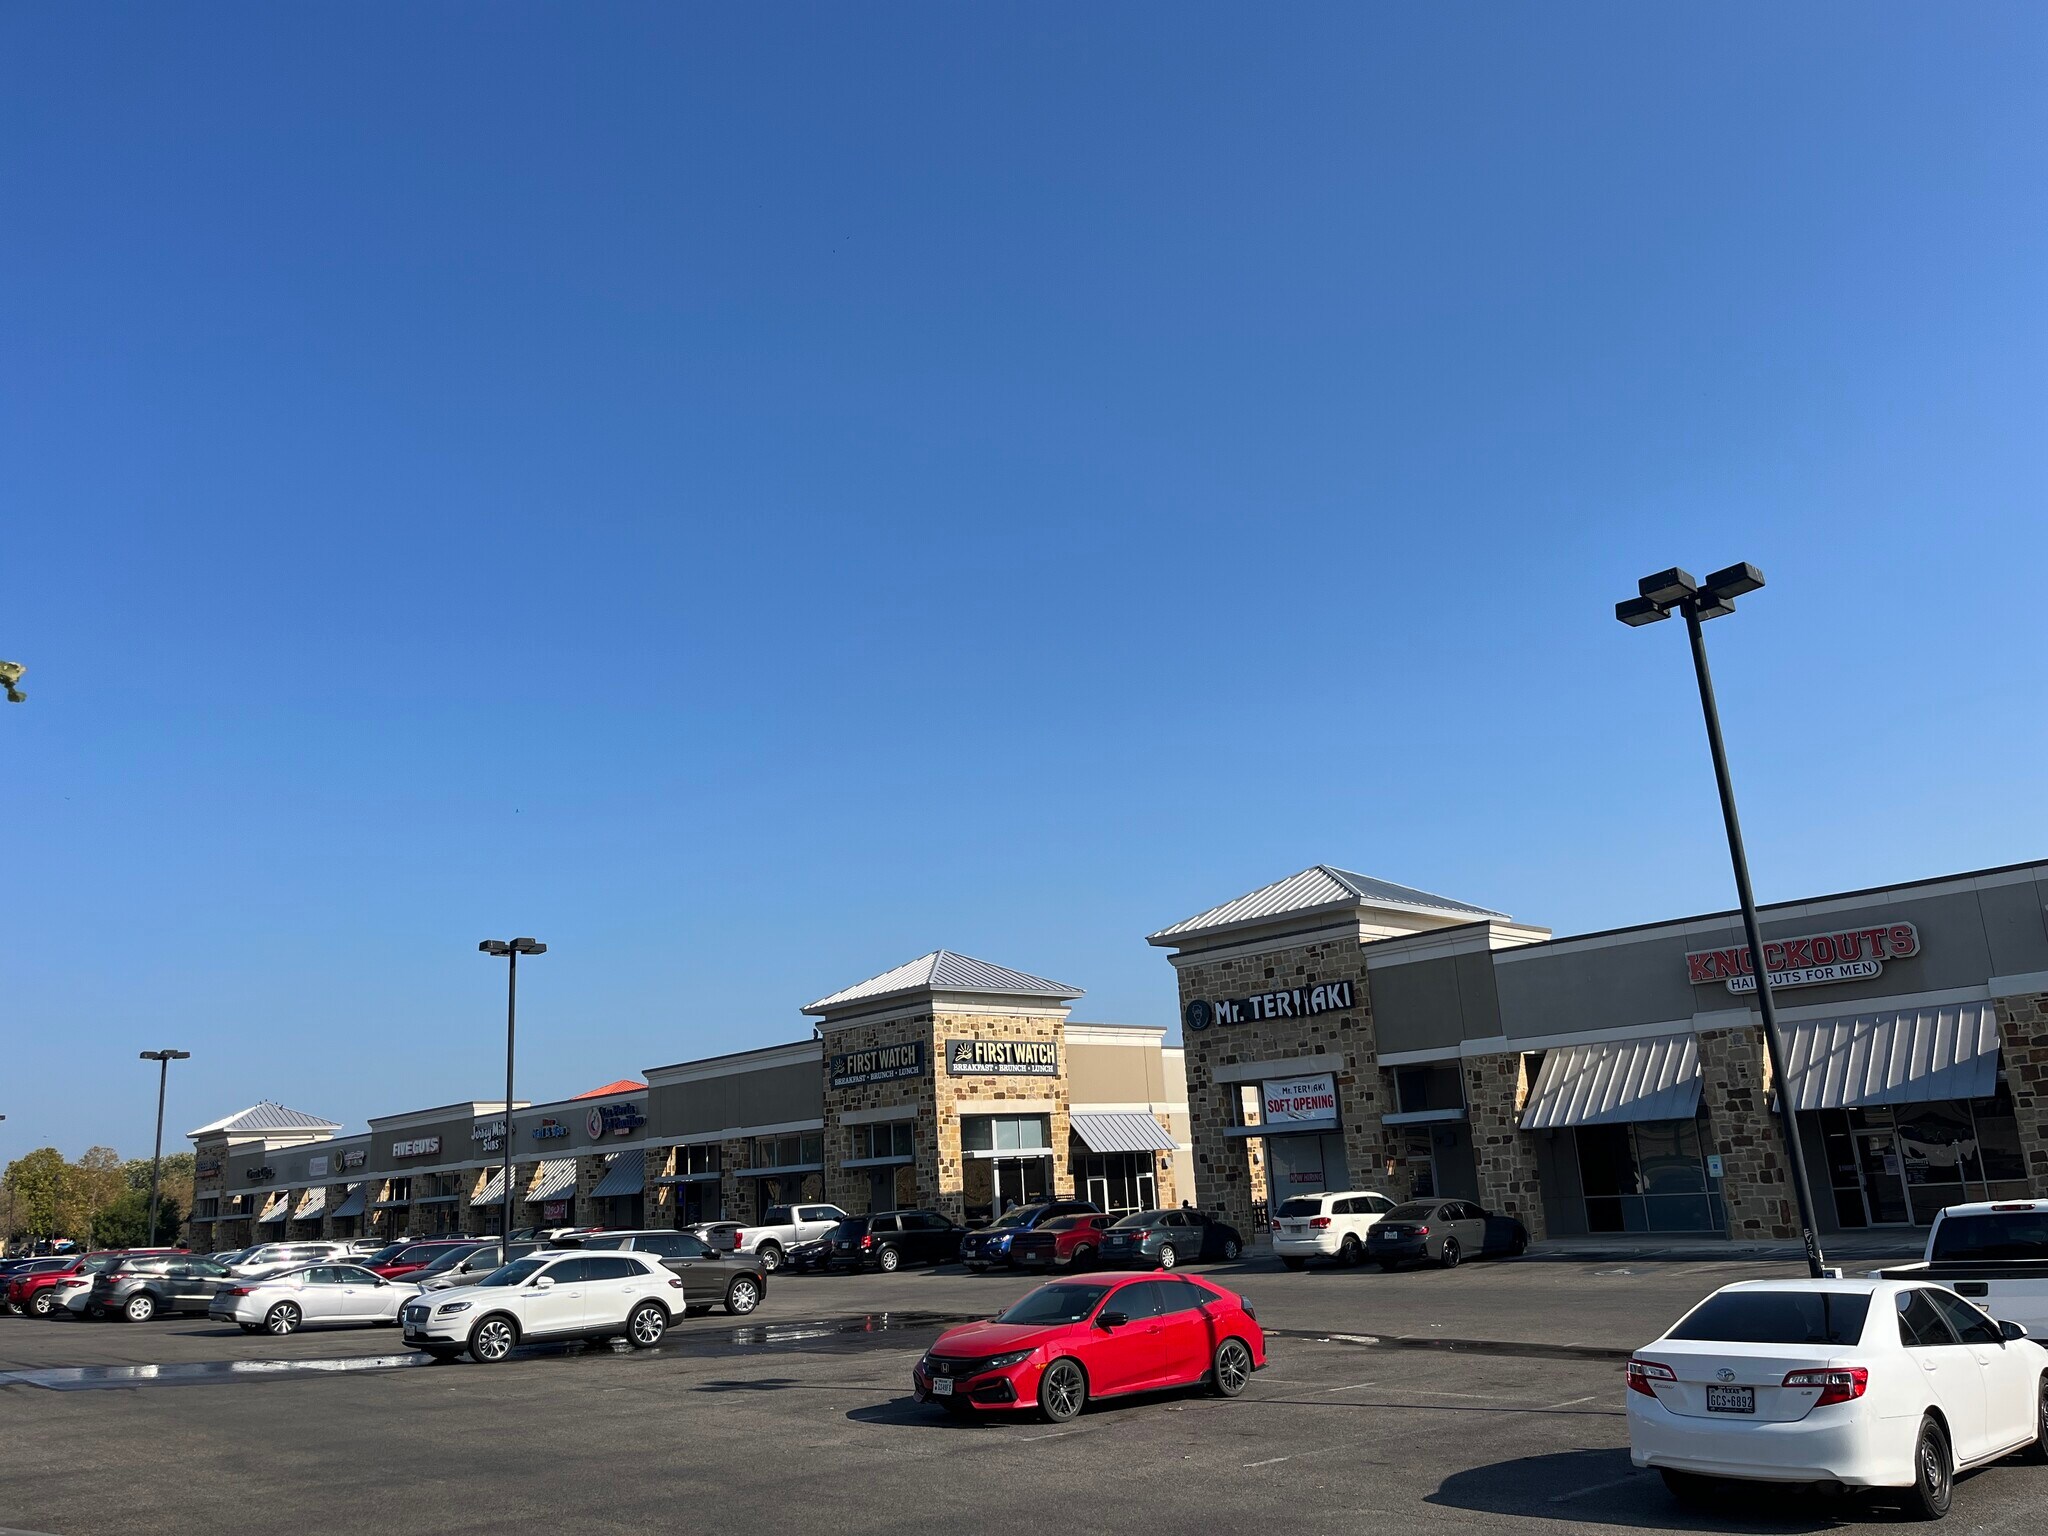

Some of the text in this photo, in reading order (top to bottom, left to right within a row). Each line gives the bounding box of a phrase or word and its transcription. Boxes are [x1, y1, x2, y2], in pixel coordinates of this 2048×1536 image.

[1687, 924, 1916, 981] KNOCKOUTS
[1731, 962, 1873, 989] HAIUTS FOR MEN
[1214, 1001, 1245, 1025] Mr.
[846, 1044, 916, 1075] FIRST WATCH
[975, 1042, 1056, 1064] FIRST WATCH
[834, 1066, 919, 1086] BREAKFAST BRUNCH LUNCH
[953, 1063, 1054, 1073] BREAKFAST BRUNCH LUNCH
[1267, 1094, 1334, 1113] SOFT OPENING
[392, 1137, 439, 1157] FIVE GUYS
